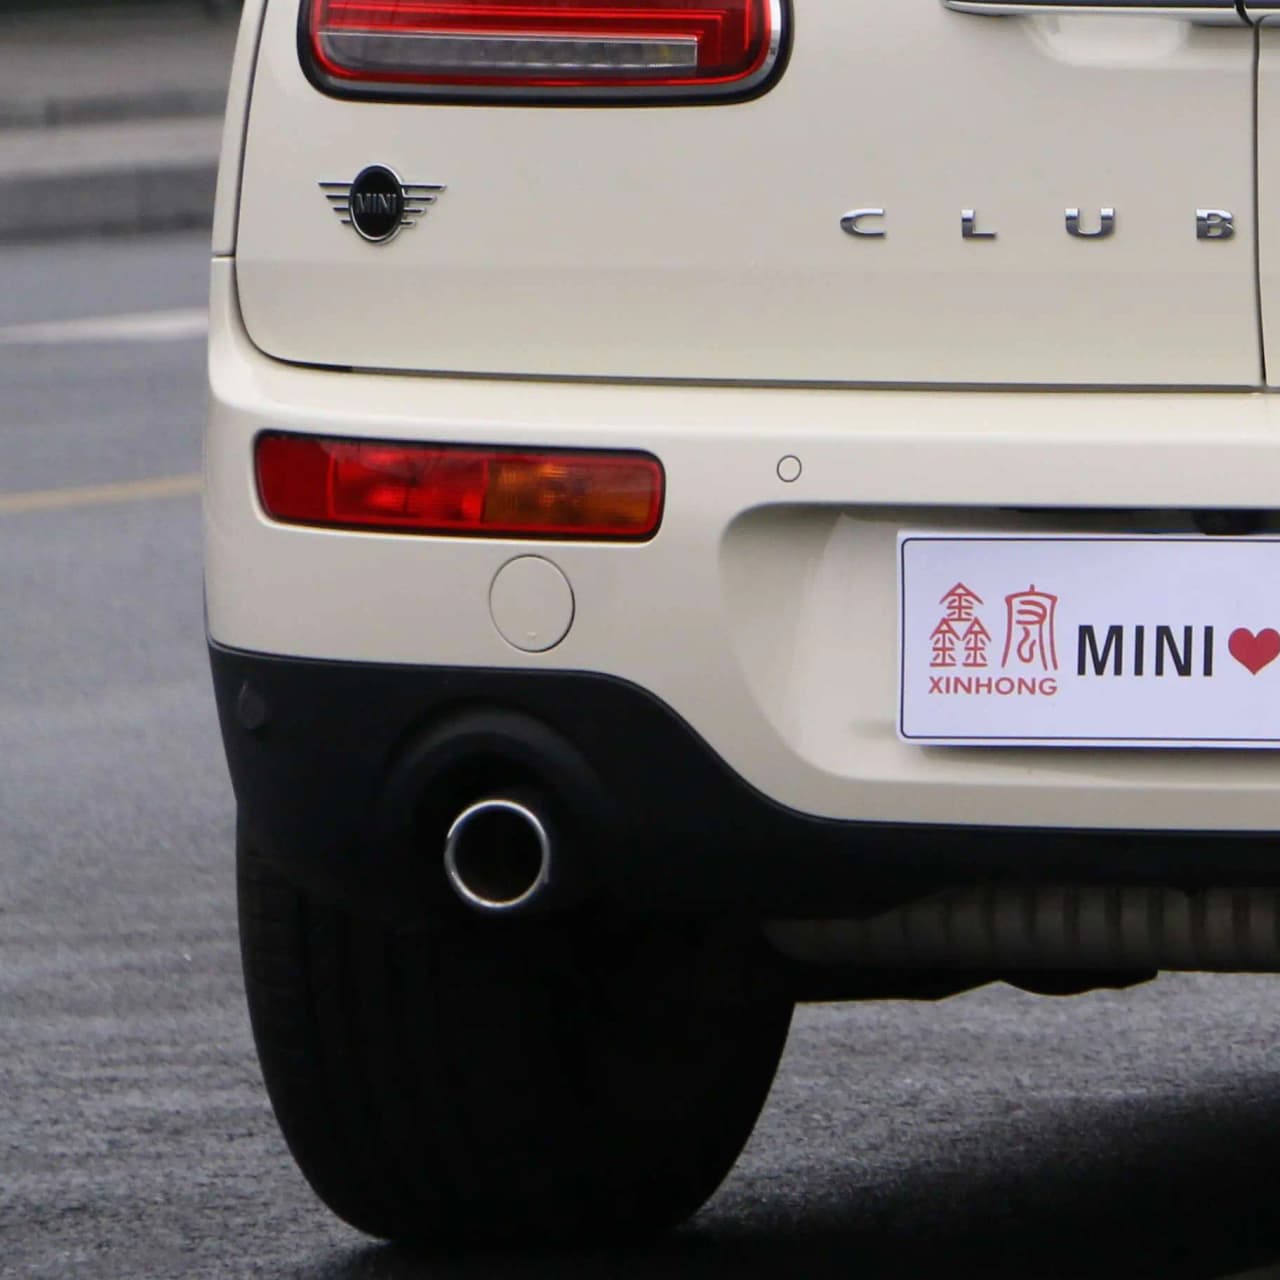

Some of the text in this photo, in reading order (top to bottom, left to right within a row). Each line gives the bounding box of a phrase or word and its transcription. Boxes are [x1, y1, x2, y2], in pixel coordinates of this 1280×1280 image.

[355, 192, 397, 215] MINI
[1075, 624, 1214, 677] MINI
[928, 675, 1059, 696] XINHONG
